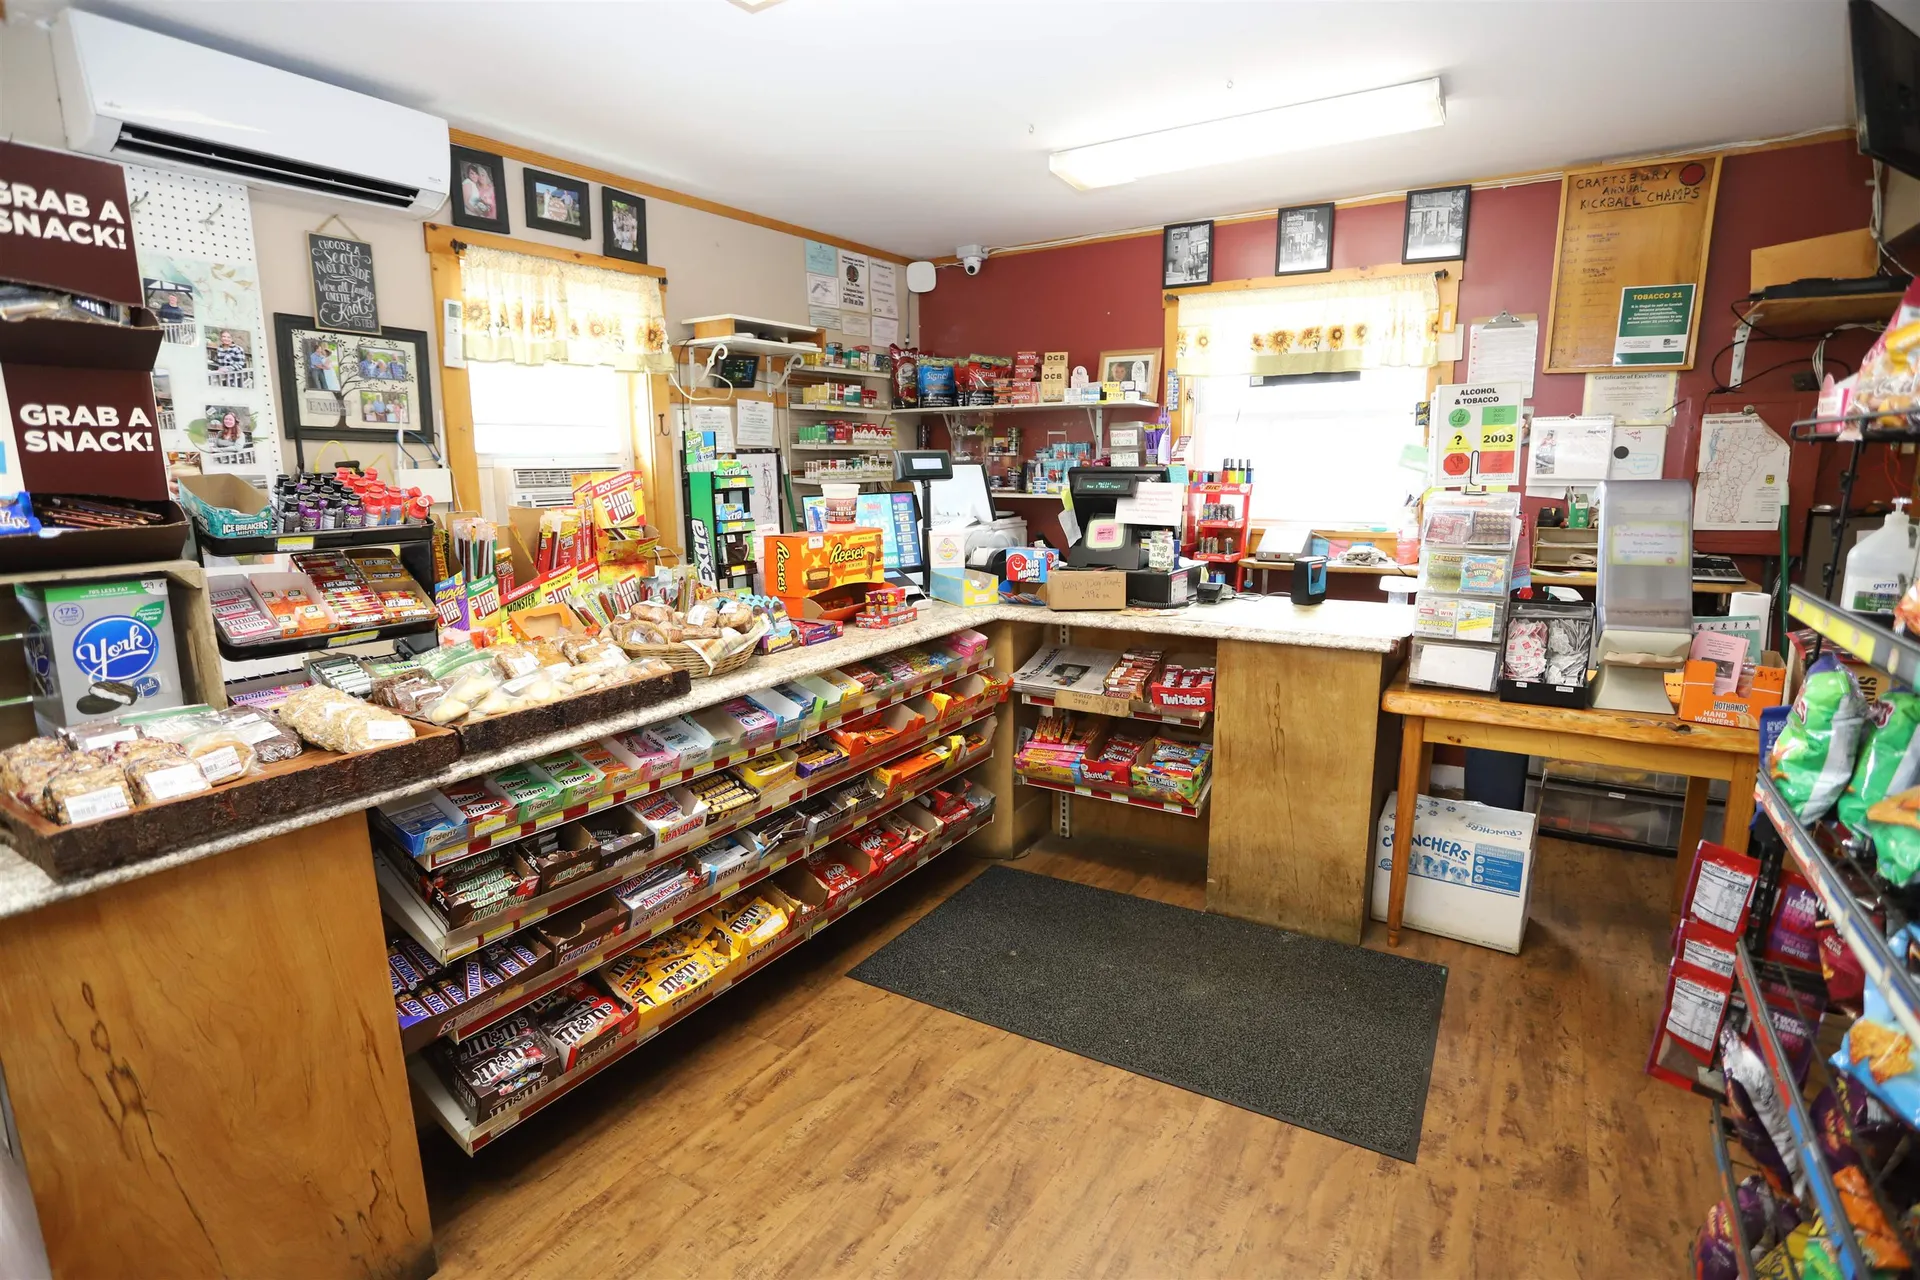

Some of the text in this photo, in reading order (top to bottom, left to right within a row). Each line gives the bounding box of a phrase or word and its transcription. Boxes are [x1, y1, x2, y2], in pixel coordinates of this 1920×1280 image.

[1576, 169, 1671, 189] CRAFTSBURY
[1602, 184, 1647, 195] ANNUAL
[1580, 186, 1700, 210] KICKBALL CHAMPS
[99, 200, 125, 225] A
[318, 240, 361, 255] CHOOSE A
[315, 261, 371, 284] NOT A SIDE
[1633, 291, 1683, 301] TOBACCO 21
[1460, 387, 1497, 396] ALCOHOL
[1462, 396, 1500, 405] TOBACCO
[19, 404, 153, 427] GRAB A
[24, 430, 155, 453] SNACK!
[1483, 434, 1514, 444] 2003
[596, 482, 611, 494] 120
[602, 491, 632, 511] slim
[613, 501, 635, 525] jim
[222, 519, 269, 535] ICE BREAKERS
[829, 543, 865, 564] Reese's
[548, 563, 572, 579] ORIGINAL
[776, 540, 790, 595] Reese's
[1026, 559, 1039, 569] AIR
[547, 573, 573, 589] TWIN PACK
[1017, 568, 1040, 580] HEADS
[507, 583, 535, 600] ORIGINAL
[214, 601, 250, 613] ALTOIDS
[471, 590, 496, 610] slim
[506, 592, 536, 614] MONSTER
[58, 606, 79, 616] 175
[441, 608, 460, 627] jim
[478, 600, 498, 620] jim
[231, 619, 270, 633] ALTOIDS
[76, 625, 153, 685] York
[136, 677, 158, 698] York
[1160, 693, 1206, 706] Twizzlers
[1713, 701, 1749, 713] HOTHANDS
[1694, 715, 1735, 727] WARMERS
[1703, 710, 1728, 718] HAND
[544, 758, 575, 773] Trident
[560, 772, 591, 787] Trident
[1083, 770, 1113, 781] Skittles
[450, 790, 485, 805] Trident
[514, 786, 547, 800] Trident
[572, 785, 598, 797] Trident
[466, 801, 501, 816] Trident
[527, 799, 555, 812] Trident
[644, 802, 675, 820] AYDAY
[425, 829, 458, 845] Trident
[663, 815, 704, 843] PAYDAY
[1466, 822, 1523, 837] CRUNCHERS
[1382, 834, 1472, 862] CNCHERS
[527, 855, 537, 868] 36
[471, 894, 525, 922] Milky Way
[560, 937, 601, 964] SNICKERS
[468, 961, 481, 998] SNICKERS
[554, 1002, 613, 1047] m&m's
[473, 1040, 534, 1084] m&m's
